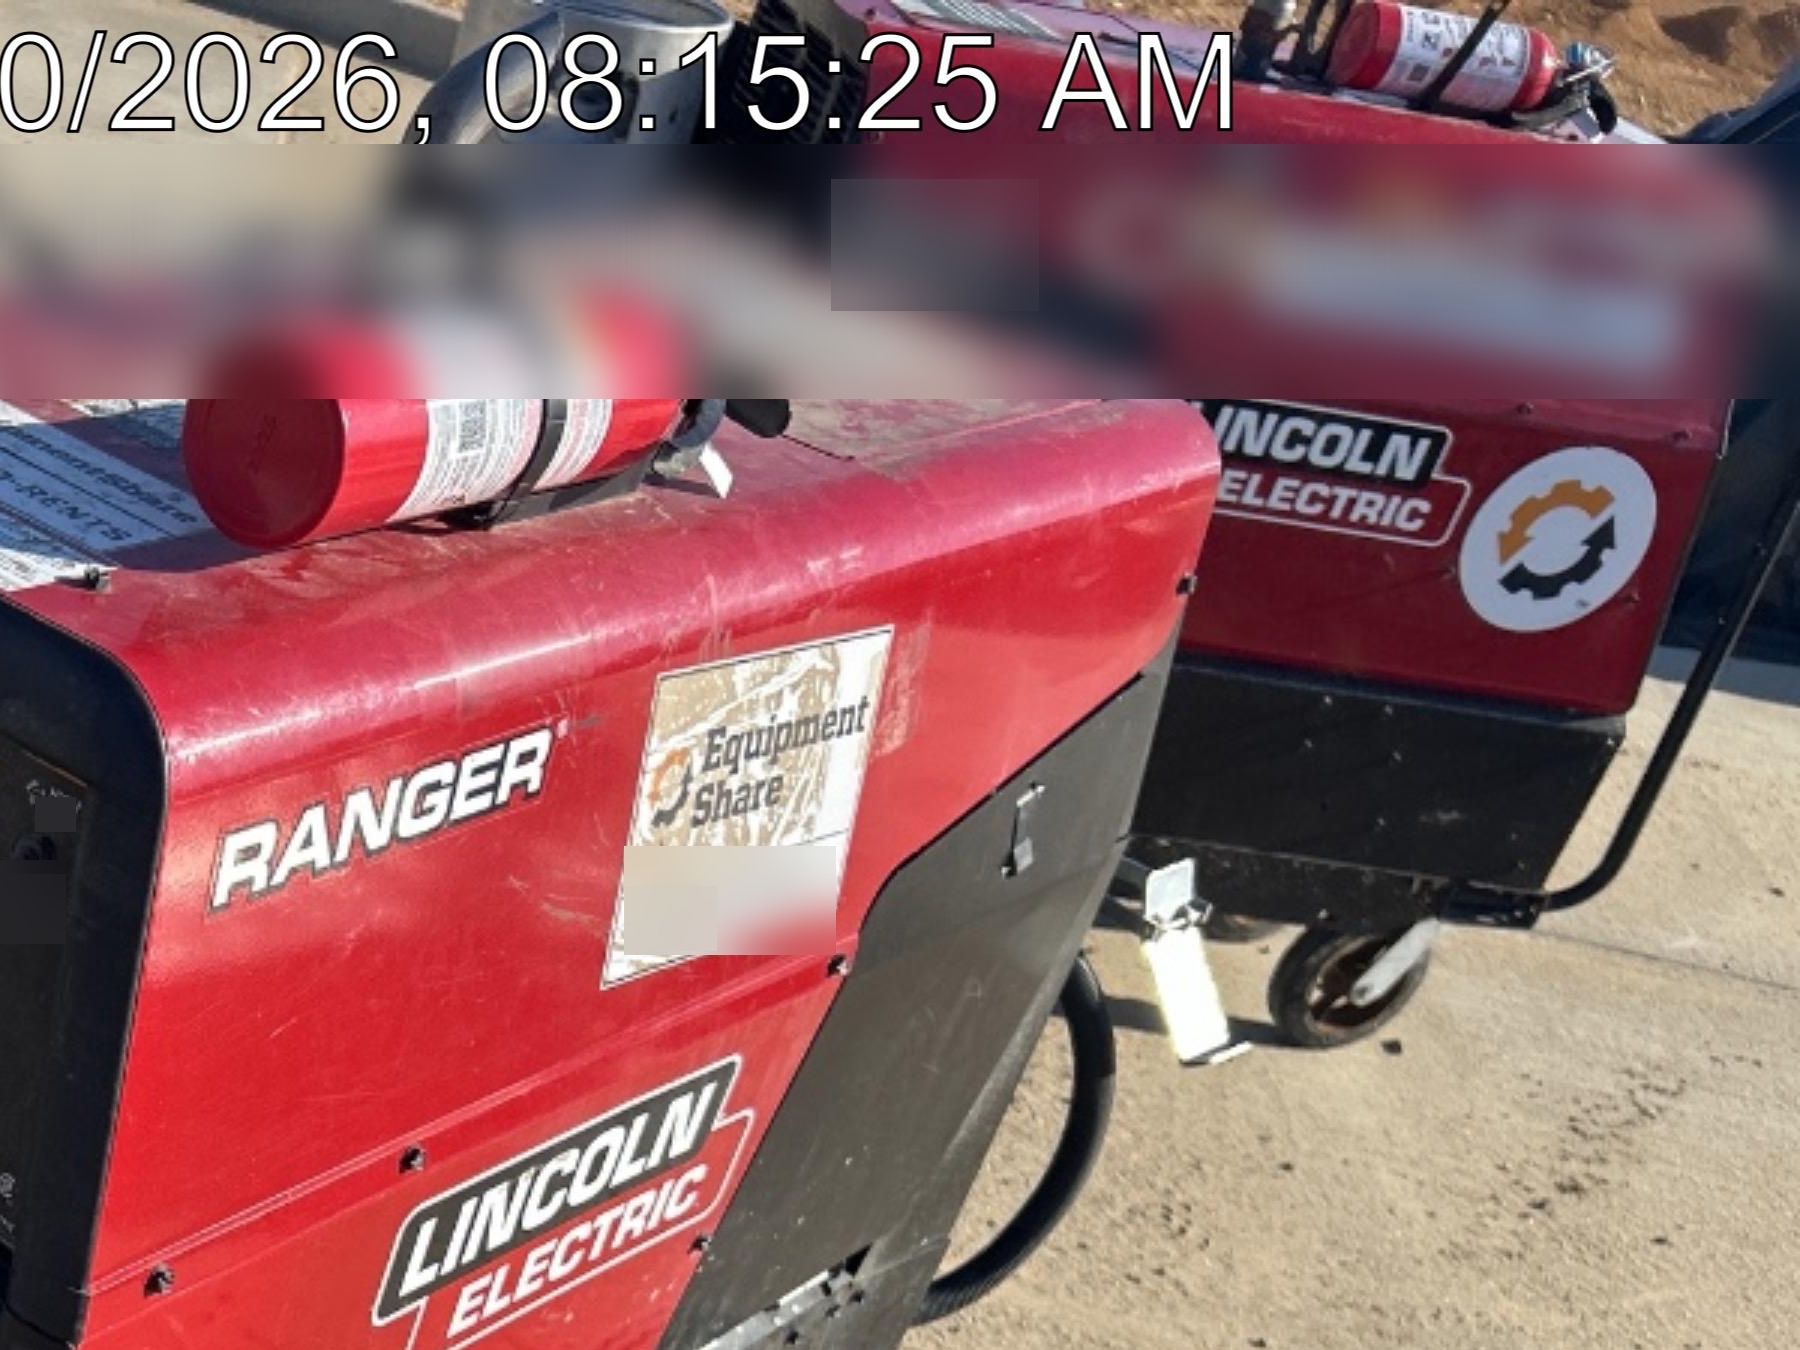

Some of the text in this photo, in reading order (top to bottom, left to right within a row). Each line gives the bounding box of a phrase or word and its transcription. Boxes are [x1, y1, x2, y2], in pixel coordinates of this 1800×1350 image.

[1214, 405, 1432, 482] INCOLN
[1216, 468, 1432, 533] ELECTRIC
[701, 696, 871, 775] Equipment
[209, 725, 553, 911] RANGER
[691, 774, 784, 829] Share
[398, 1081, 719, 1298] LINCOLN
[446, 1162, 708, 1339] ELECTRIC
